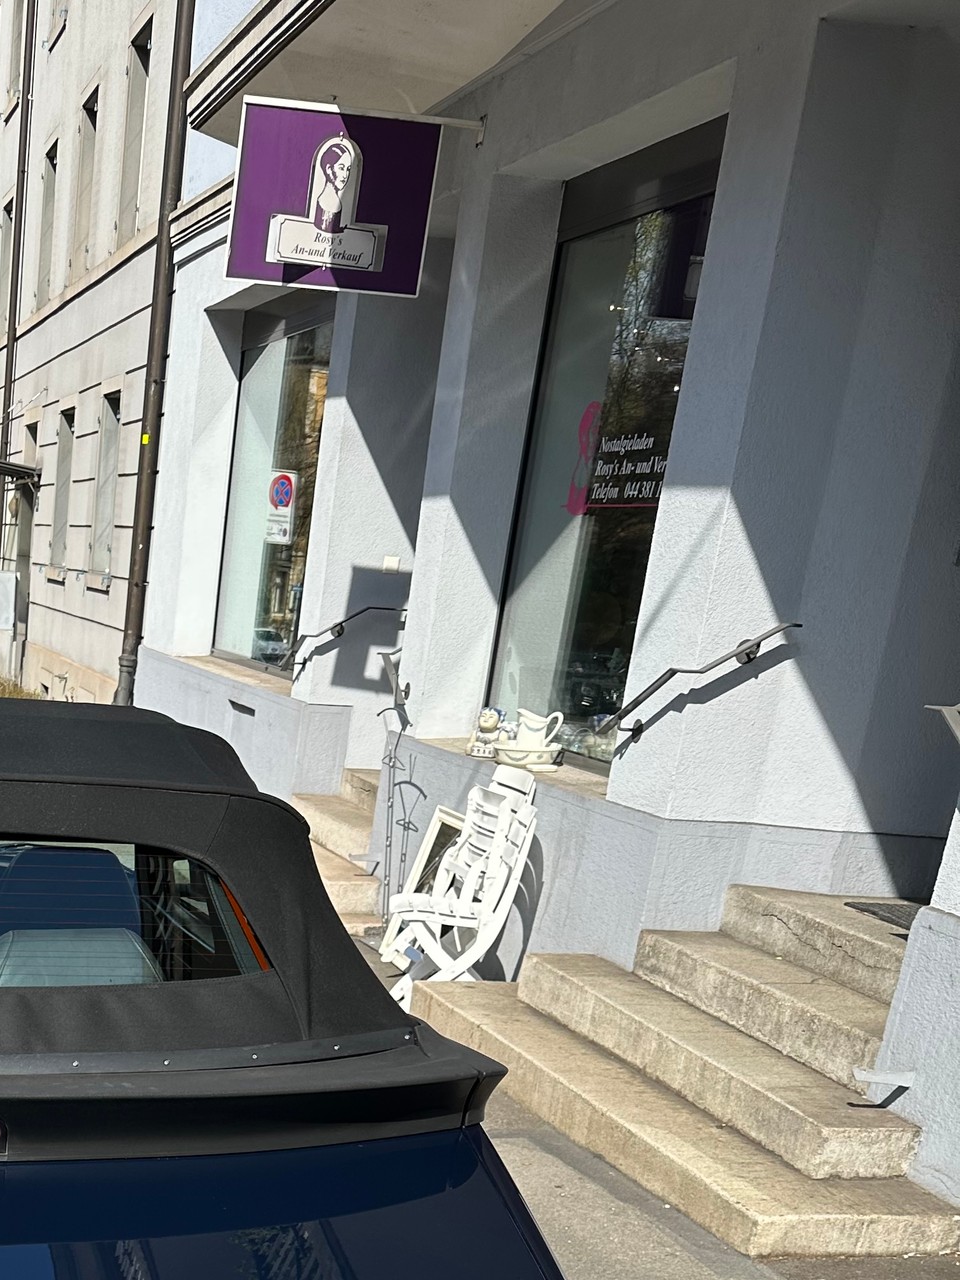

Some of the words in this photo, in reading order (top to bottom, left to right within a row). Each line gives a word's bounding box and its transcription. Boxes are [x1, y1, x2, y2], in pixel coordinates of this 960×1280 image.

[329, 249, 363, 264] Verkauf
[598, 433, 654, 455] Nostalgieladen
[595, 459, 619, 479] Rosy's
[618, 458, 635, 475] An-
[635, 456, 654, 474] und
[591, 482, 619, 503] Telefon
[623, 481, 640, 498] 044
[639, 481, 656, 498] 381
